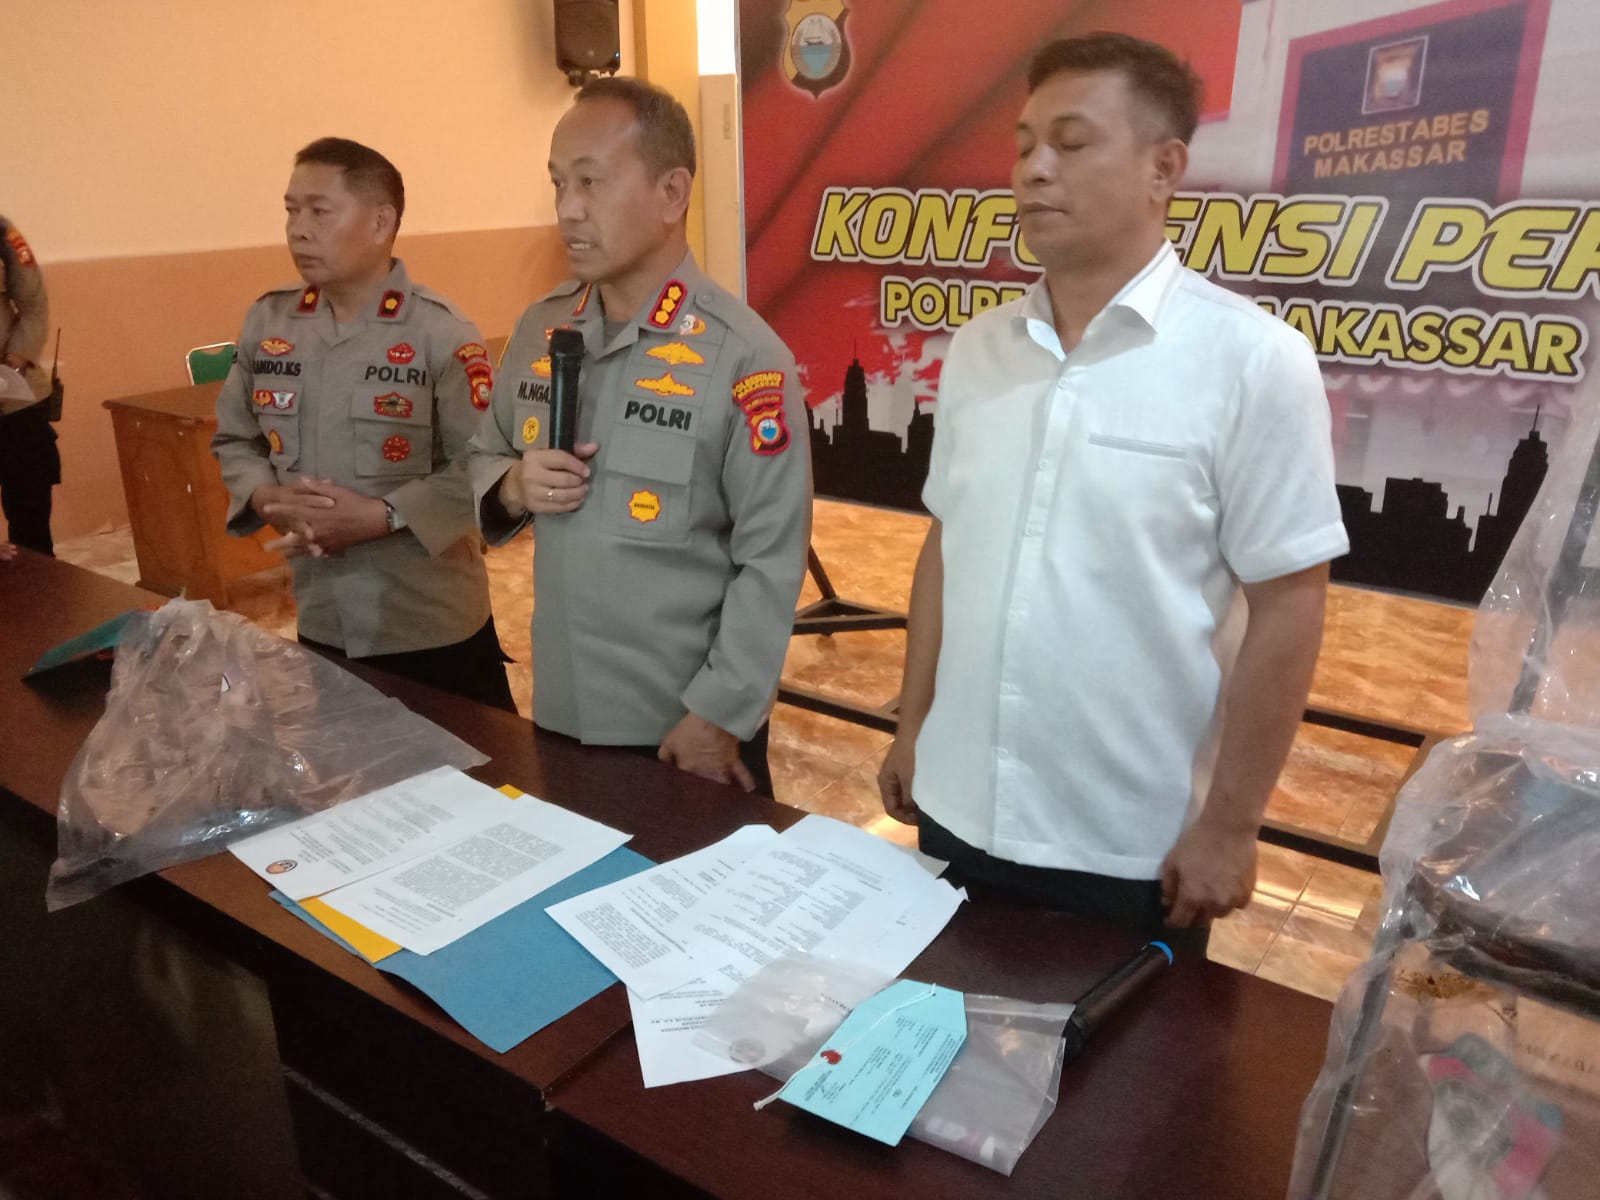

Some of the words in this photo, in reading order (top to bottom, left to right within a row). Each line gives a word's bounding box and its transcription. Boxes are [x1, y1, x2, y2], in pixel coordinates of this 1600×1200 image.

[1304, 109, 1490, 157] POLRESTABES
[1314, 139, 1467, 179] MAKASSAR
[1258, 302, 1585, 378] AKASSAR
[364, 365, 427, 387] POLRI
[624, 400, 693, 432] POLRI
